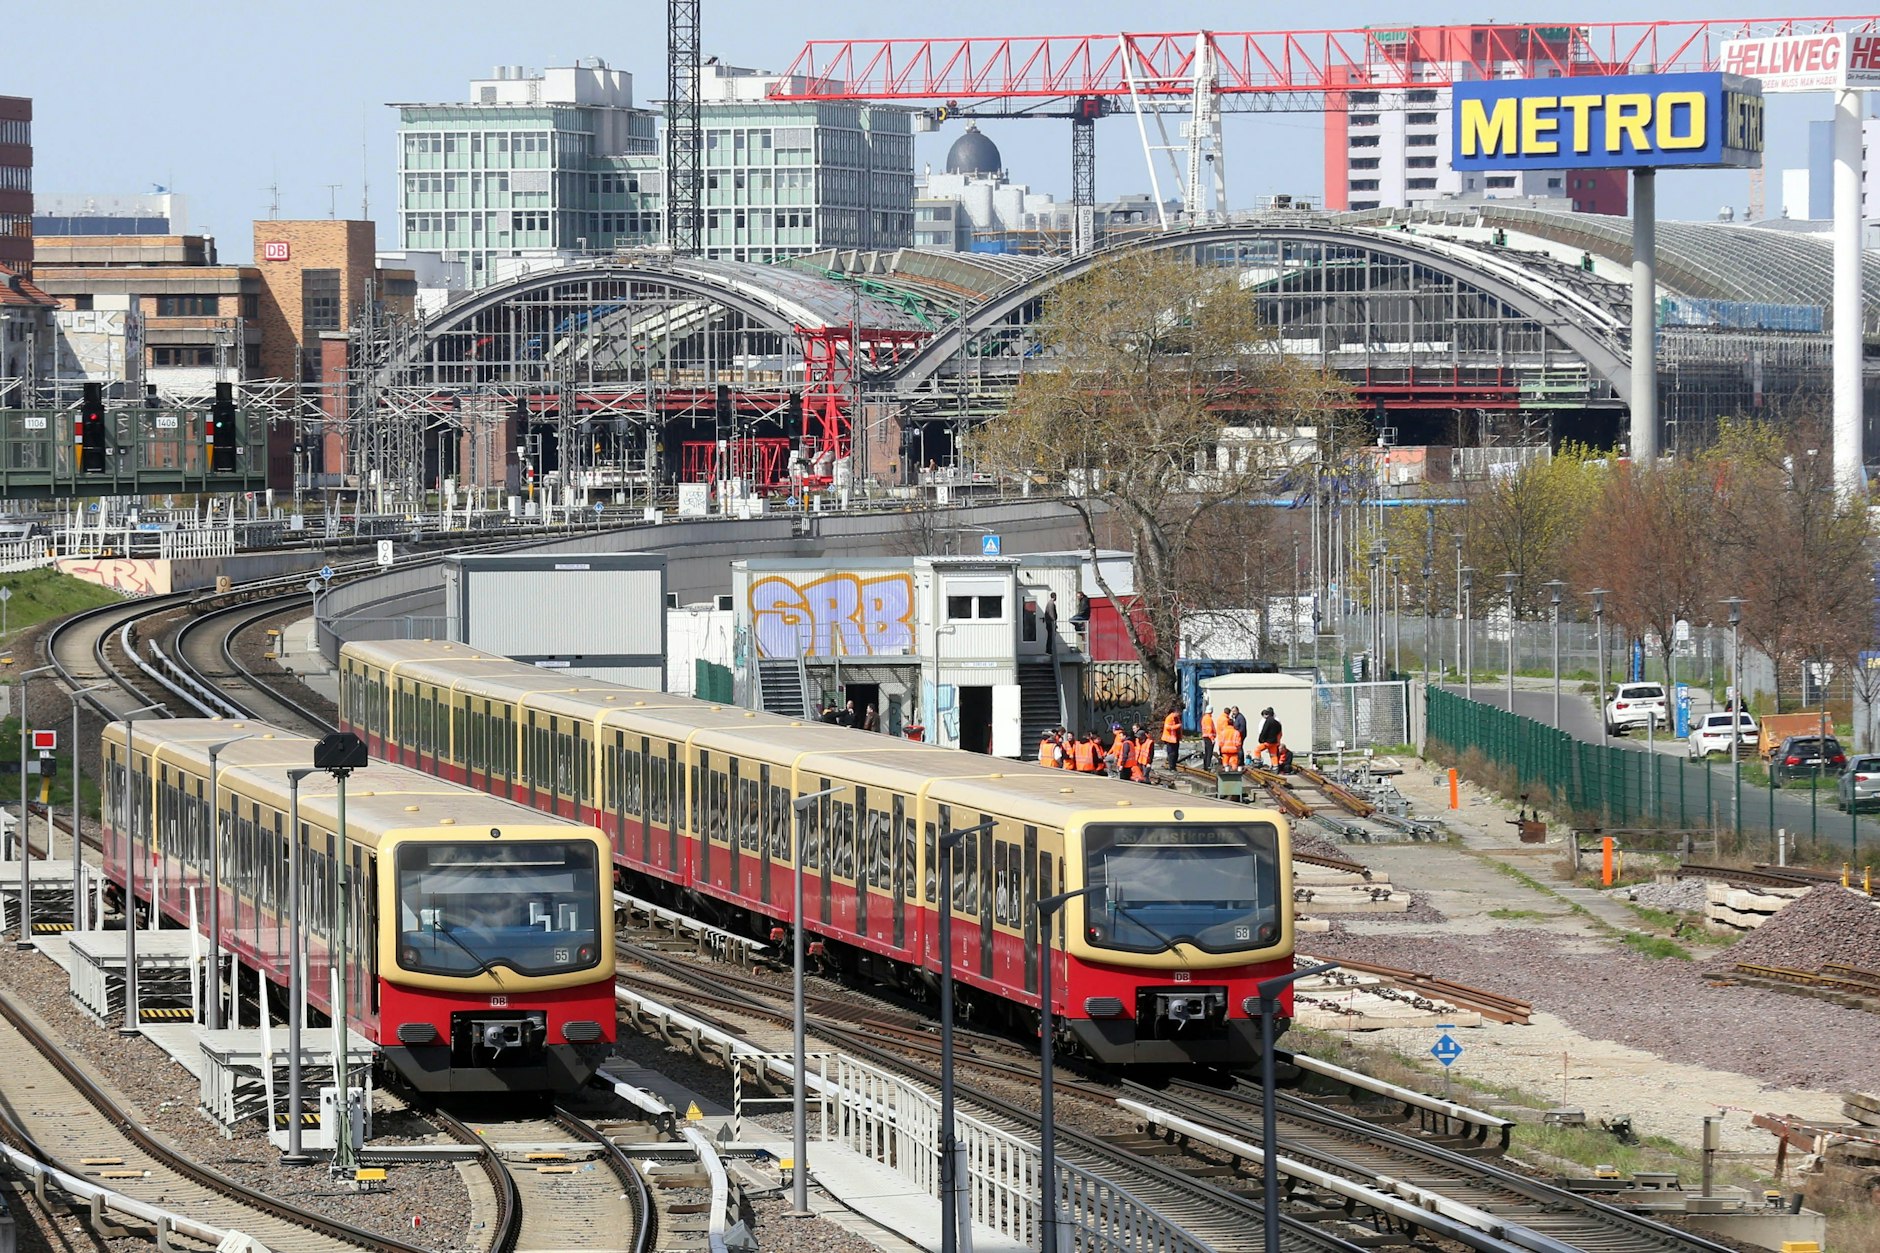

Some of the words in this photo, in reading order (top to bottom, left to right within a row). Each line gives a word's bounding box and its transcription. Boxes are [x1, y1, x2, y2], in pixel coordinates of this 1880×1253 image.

[1726, 36, 1841, 76] HELLWEG
[1762, 79, 1779, 89] DEEN
[1816, 75, 1838, 86] HABEN
[1461, 91, 1706, 156] METRO
[1728, 91, 1764, 152] METRO
[267, 244, 286, 256] DB
[27, 418, 45, 428] 1106
[157, 417, 177, 427] 1406
[382, 552, 389, 562] 6
[1236, 927, 1249, 938] 58
[555, 950, 568, 961] 55
[1176, 973, 1189, 981] DB
[492, 997, 506, 1006] DB
